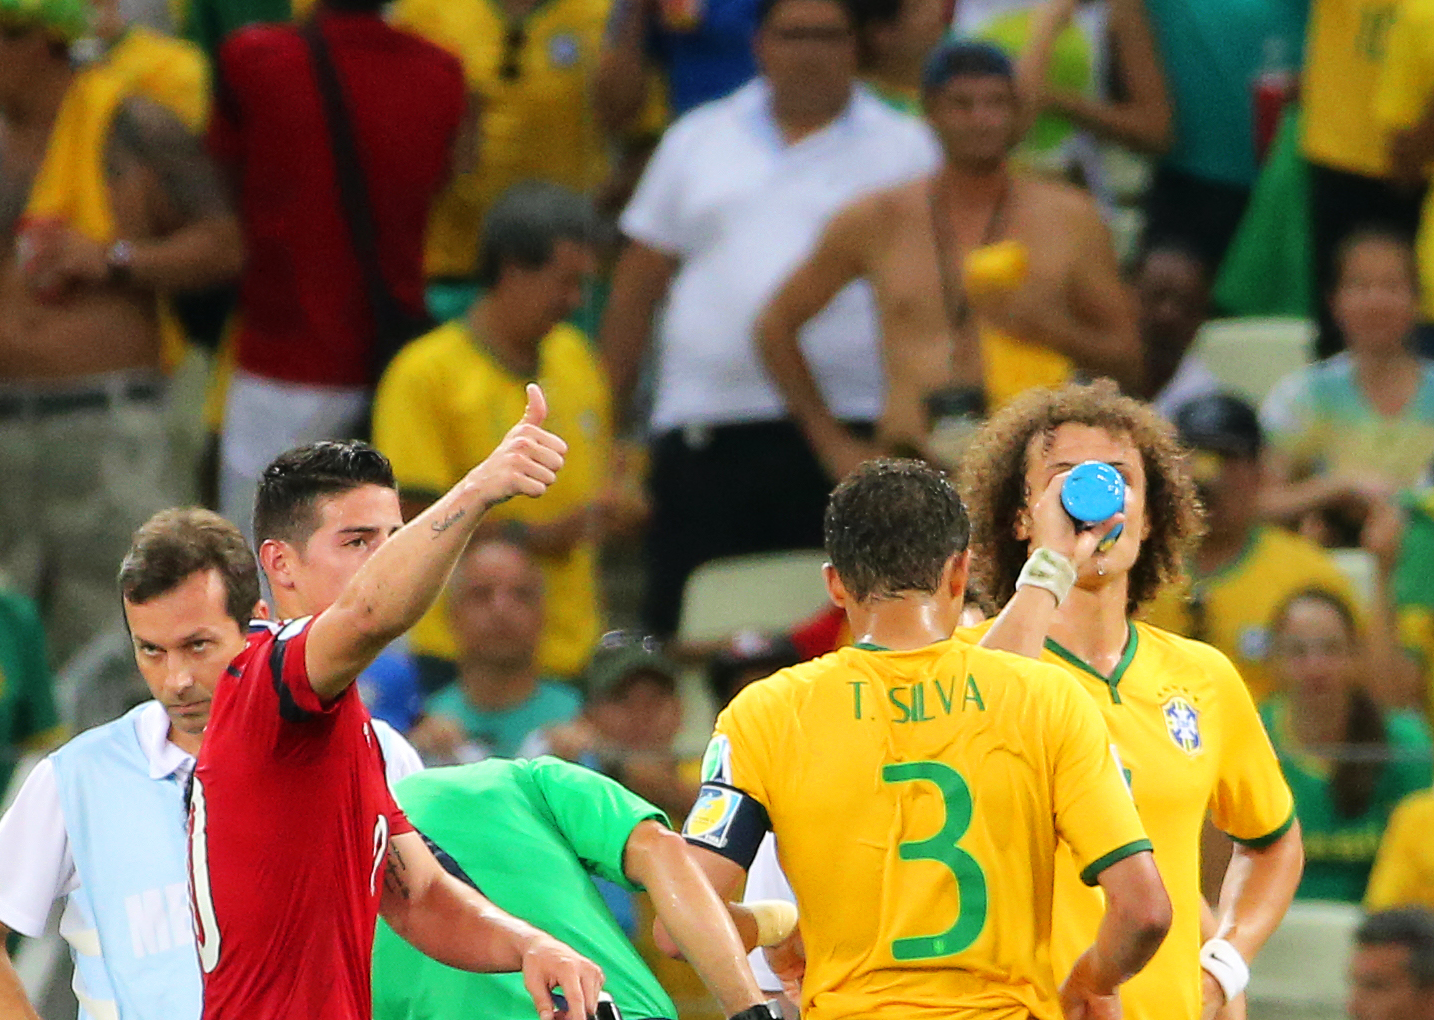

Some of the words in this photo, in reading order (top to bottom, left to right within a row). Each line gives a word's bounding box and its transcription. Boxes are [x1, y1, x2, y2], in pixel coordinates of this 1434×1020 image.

[847, 681, 876, 721] T.
[887, 673, 986, 723] SILVA
[881, 761, 988, 961] 3
